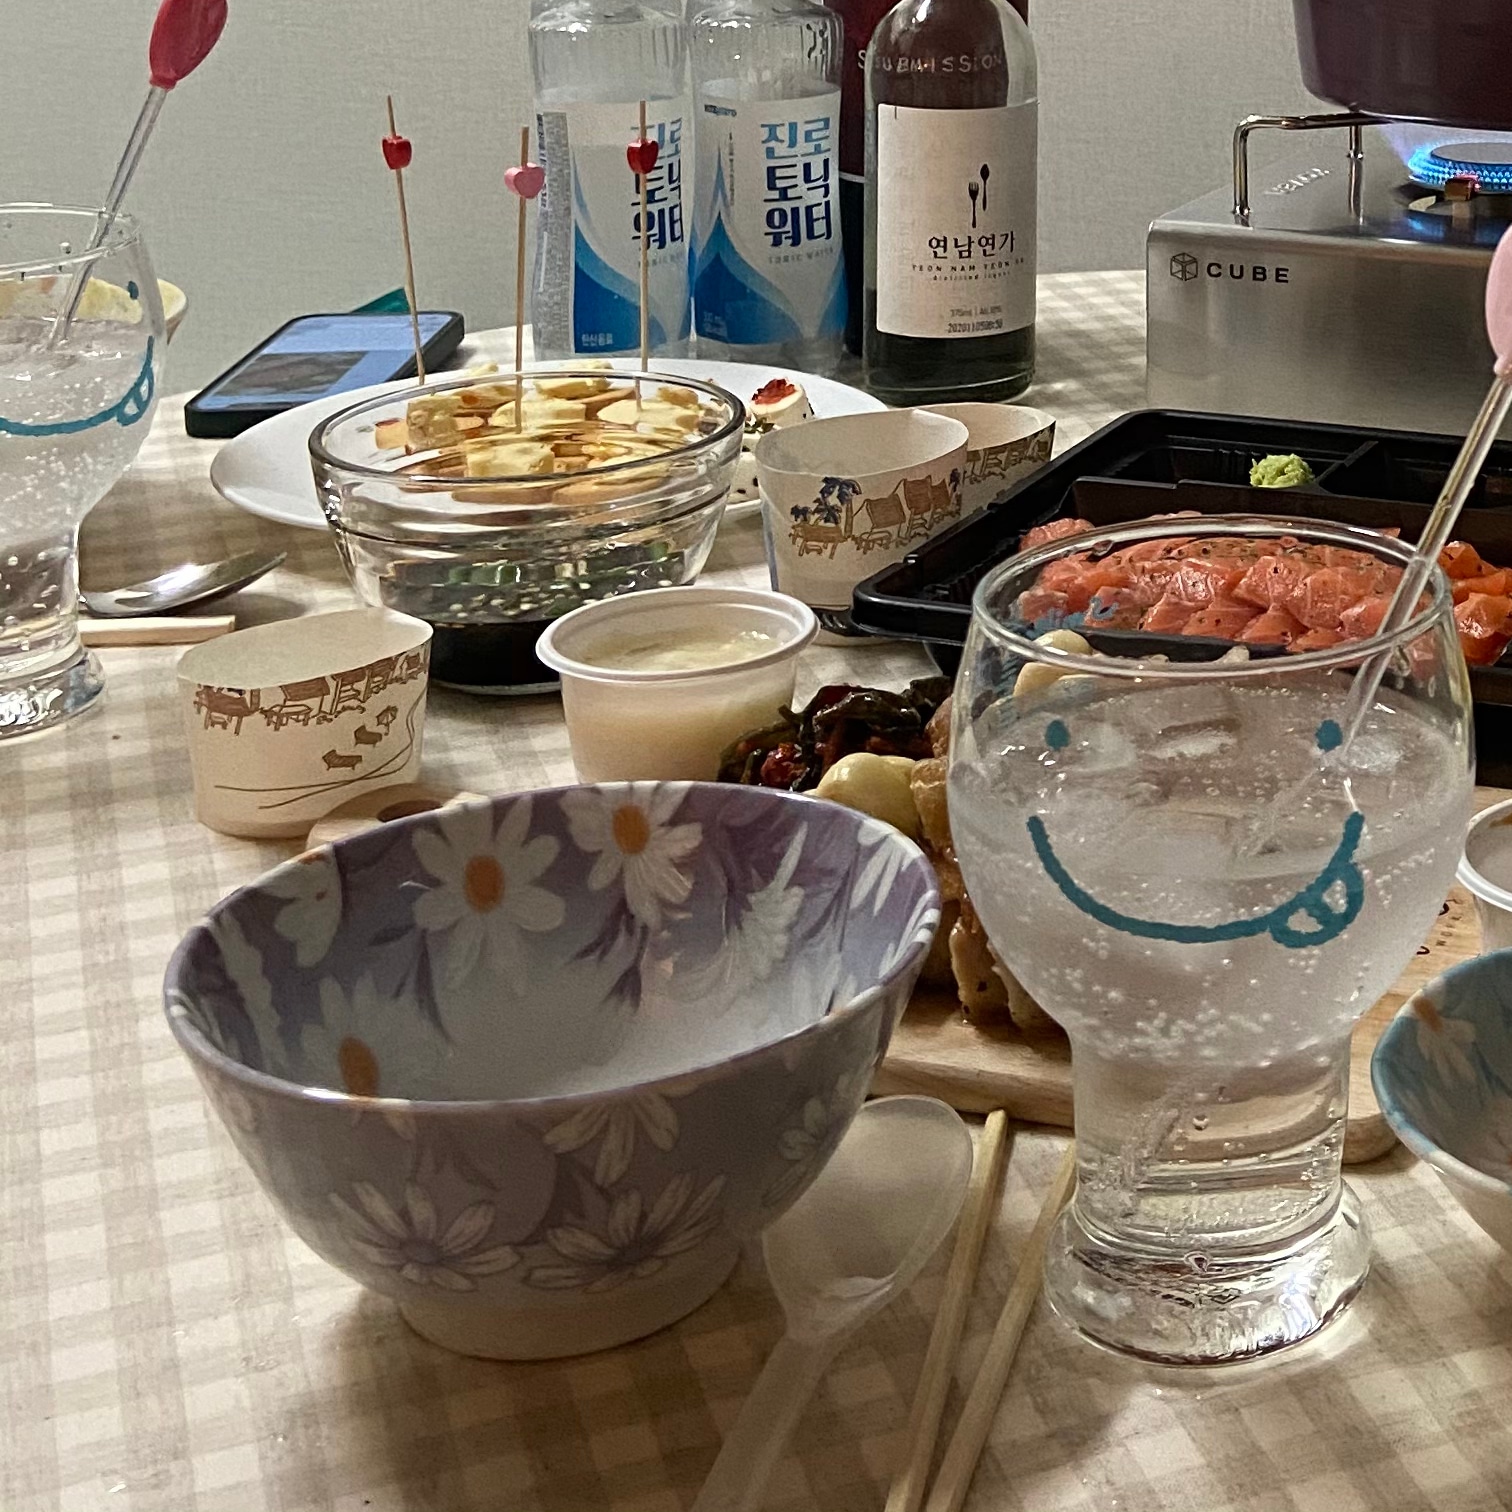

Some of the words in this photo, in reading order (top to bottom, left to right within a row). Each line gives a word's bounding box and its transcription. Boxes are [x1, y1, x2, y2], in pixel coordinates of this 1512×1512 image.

[760, 116, 831, 160] 진로
[763, 157, 831, 202] 토닉
[763, 199, 833, 247] 워터
[928, 230, 1016, 260] 연남연가
[950, 264, 976, 272] NAM
[1206, 262, 1290, 284] CUBE
